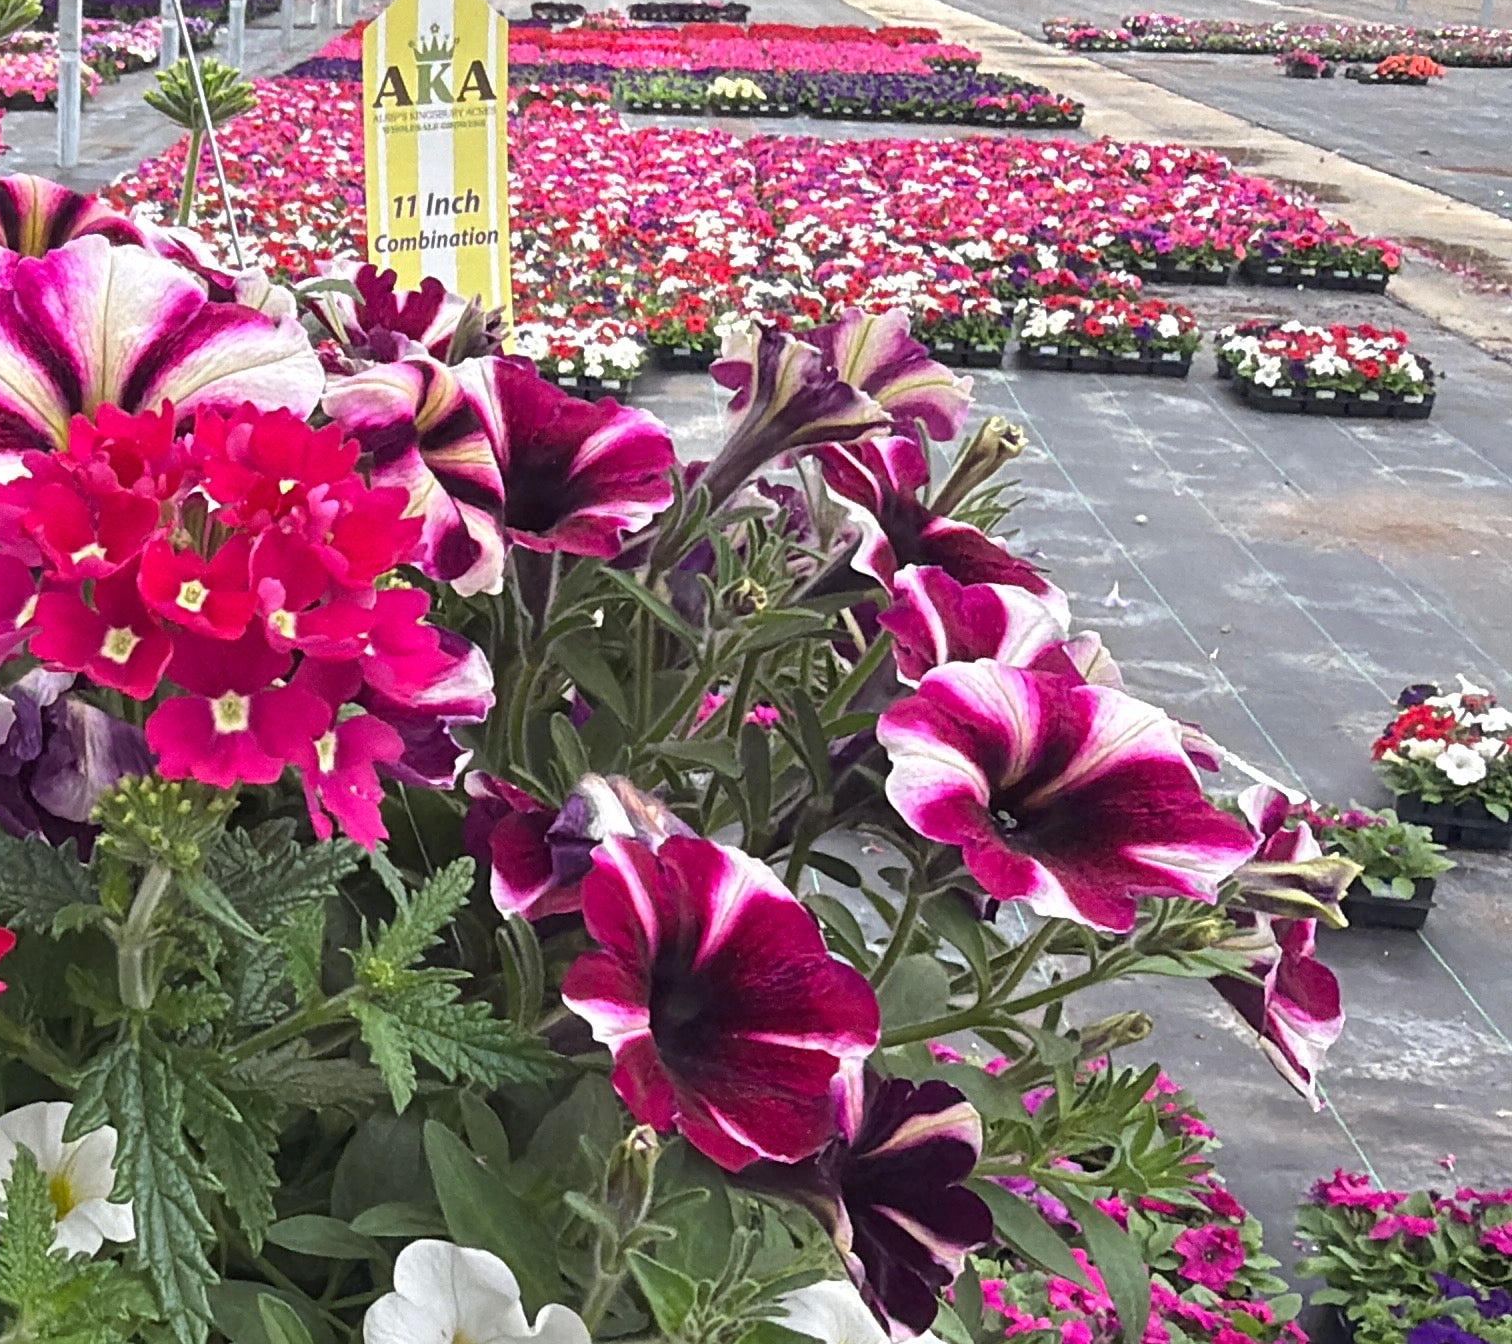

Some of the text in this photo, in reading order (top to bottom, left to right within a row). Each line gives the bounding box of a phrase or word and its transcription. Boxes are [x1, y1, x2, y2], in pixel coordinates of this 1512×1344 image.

[372, 59, 497, 108] AKA
[393, 188, 481, 219] 11 Inch
[374, 226, 499, 253] Combination
